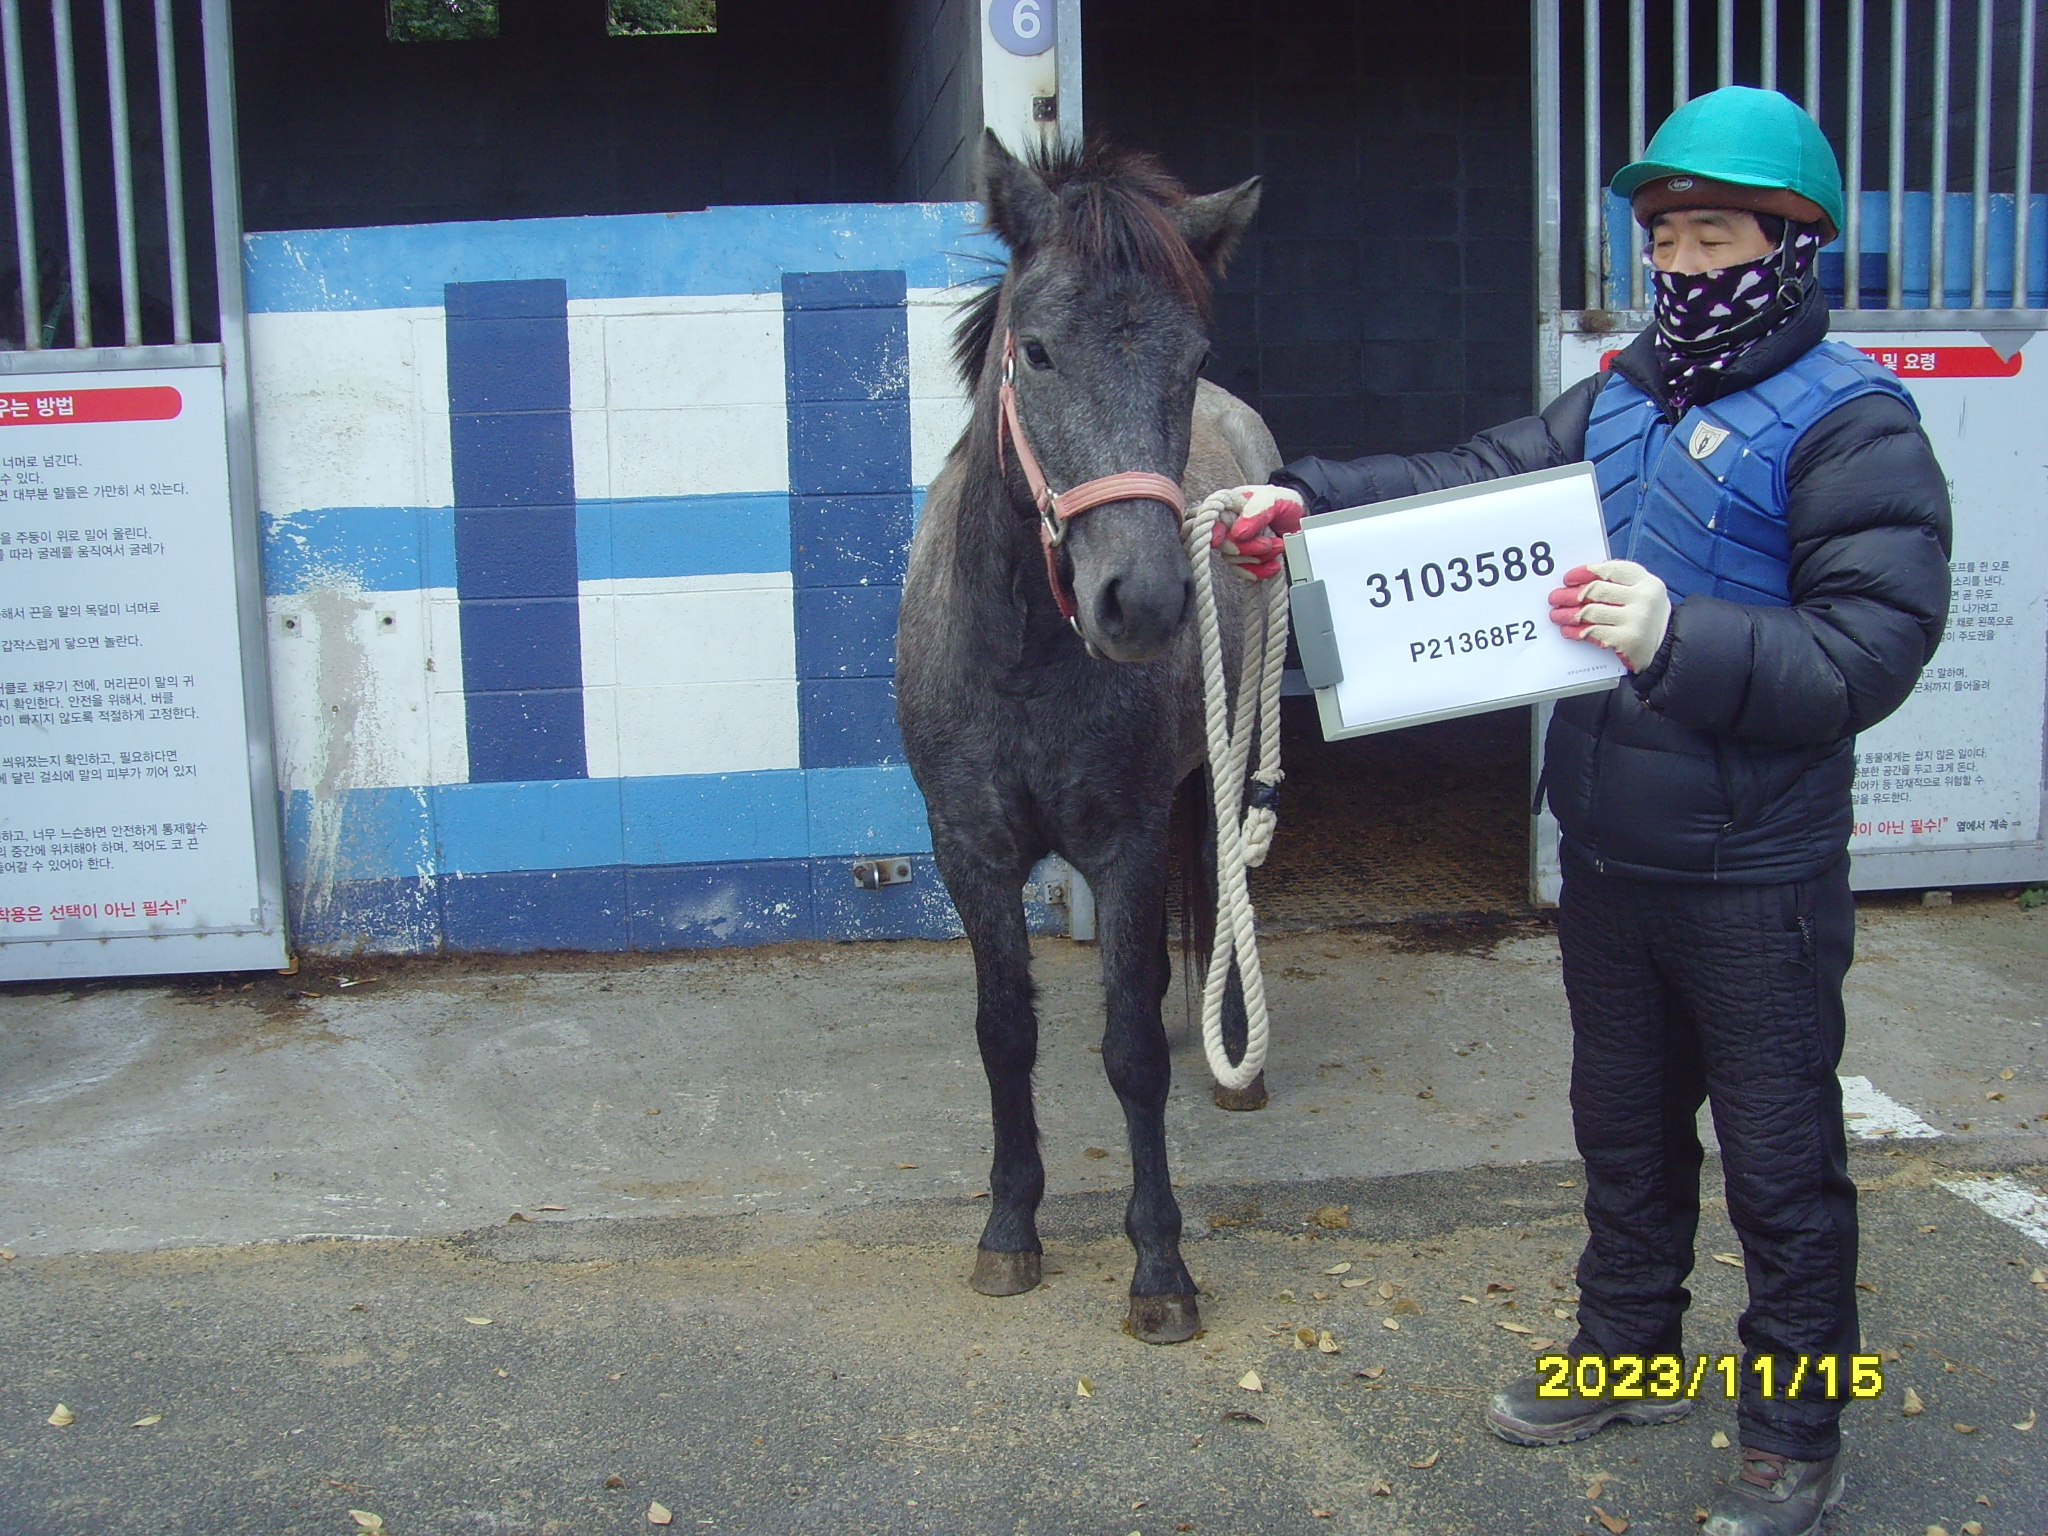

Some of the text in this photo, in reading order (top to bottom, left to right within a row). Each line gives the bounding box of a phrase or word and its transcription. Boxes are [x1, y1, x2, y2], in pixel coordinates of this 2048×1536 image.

[1013, 0, 1040, 38] 6
[1903, 353, 1935, 371] 요령
[36, 396, 74, 417] 방법
[3, 454, 82, 469] 너머로 넘긴다.
[1, 471, 44, 486] 수 있다.
[13, 488, 49, 501] 대부분
[53, 485, 89, 500] 말들은
[94, 484, 129, 498] 가만히
[133, 484, 146, 496] 서
[149, 482, 189, 496] 있는다.
[16, 531, 52, 544] 주둥이
[57, 530, 80, 542] 위로
[85, 528, 108, 542] 밀어
[112, 527, 152, 540] 올린다.
[10, 548, 33, 561] 따라
[37, 546, 73, 560] 굴레를
[77, 544, 125, 558] 움직여서
[129, 542, 165, 556] 굴레가
[1366, 540, 1555, 608] 3103588
[1991, 561, 2009, 572] 오른
[1975, 589, 1993, 600] 유도
[0, 602, 161, 620] 해서 끈을 말의 목덜미 너머로
[1962, 603, 1998, 614] 나가려고
[1977, 616, 2014, 627] 왼쪽으로
[1, 634, 143, 652] 갑작스럽게 닿으면 놀란다.
[1409, 620, 1538, 662] P21368F2
[1958, 630, 1995, 641] 주도권을
[33, 680, 68, 693] 채우기
[72, 679, 100, 692] 전에,
[104, 677, 150, 690] 머리끈이
[154, 675, 178, 688] 말의
[182, 675, 195, 687] 귀
[13, 697, 64, 710] 확인한다.
[68, 695, 104, 708] 안전을
[108, 693, 147, 706] 위해서,
[151, 692, 174, 704] 버클
[0, 707, 200, 727] 이 빠지지 않도록 적절하게 고정한다.
[3, 750, 178, 769] 씌워졌는지 확인하고, 필요하다면
[1958, 748, 1988, 759] 일이다.
[12, 771, 35, 785] 달린
[40, 769, 75, 783] 걸쇠에
[79, 768, 102, 781] 말의
[106, 766, 142, 780] 피부가
[146, 765, 169, 778] 끼어
[173, 764, 197, 777] 있지
[1883, 765, 1910, 777] 공간을
[1914, 765, 1932, 775] 두고
[1935, 763, 1954, 774] 크게
[1957, 762, 1978, 773] 돈다.
[1895, 778, 1941, 790] 잠재적으로
[1944, 775, 1972, 787] 위험할
[1975, 775, 1985, 785] 수
[1872, 792, 1912, 805] 유도한다.
[0, 821, 209, 842] 하고, 너무 느슨하면 안전하게 통제할수
[1878, 820, 1904, 835] 아닌
[1957, 819, 2009, 833] 옆에서 계속
[11, 844, 46, 858] 중간에
[50, 842, 97, 856] 위치해야
[101, 840, 128, 854] 하며,
[132, 838, 168, 852] 적어도
[171, 839, 183, 851] 코
[187, 837, 199, 850] 끈
[32, 860, 44, 872] 수
[48, 858, 84, 872] 있어야
[87, 857, 114, 870] 한다.
[49, 903, 98, 921] 선택이
[104, 901, 136, 919] 아닌
